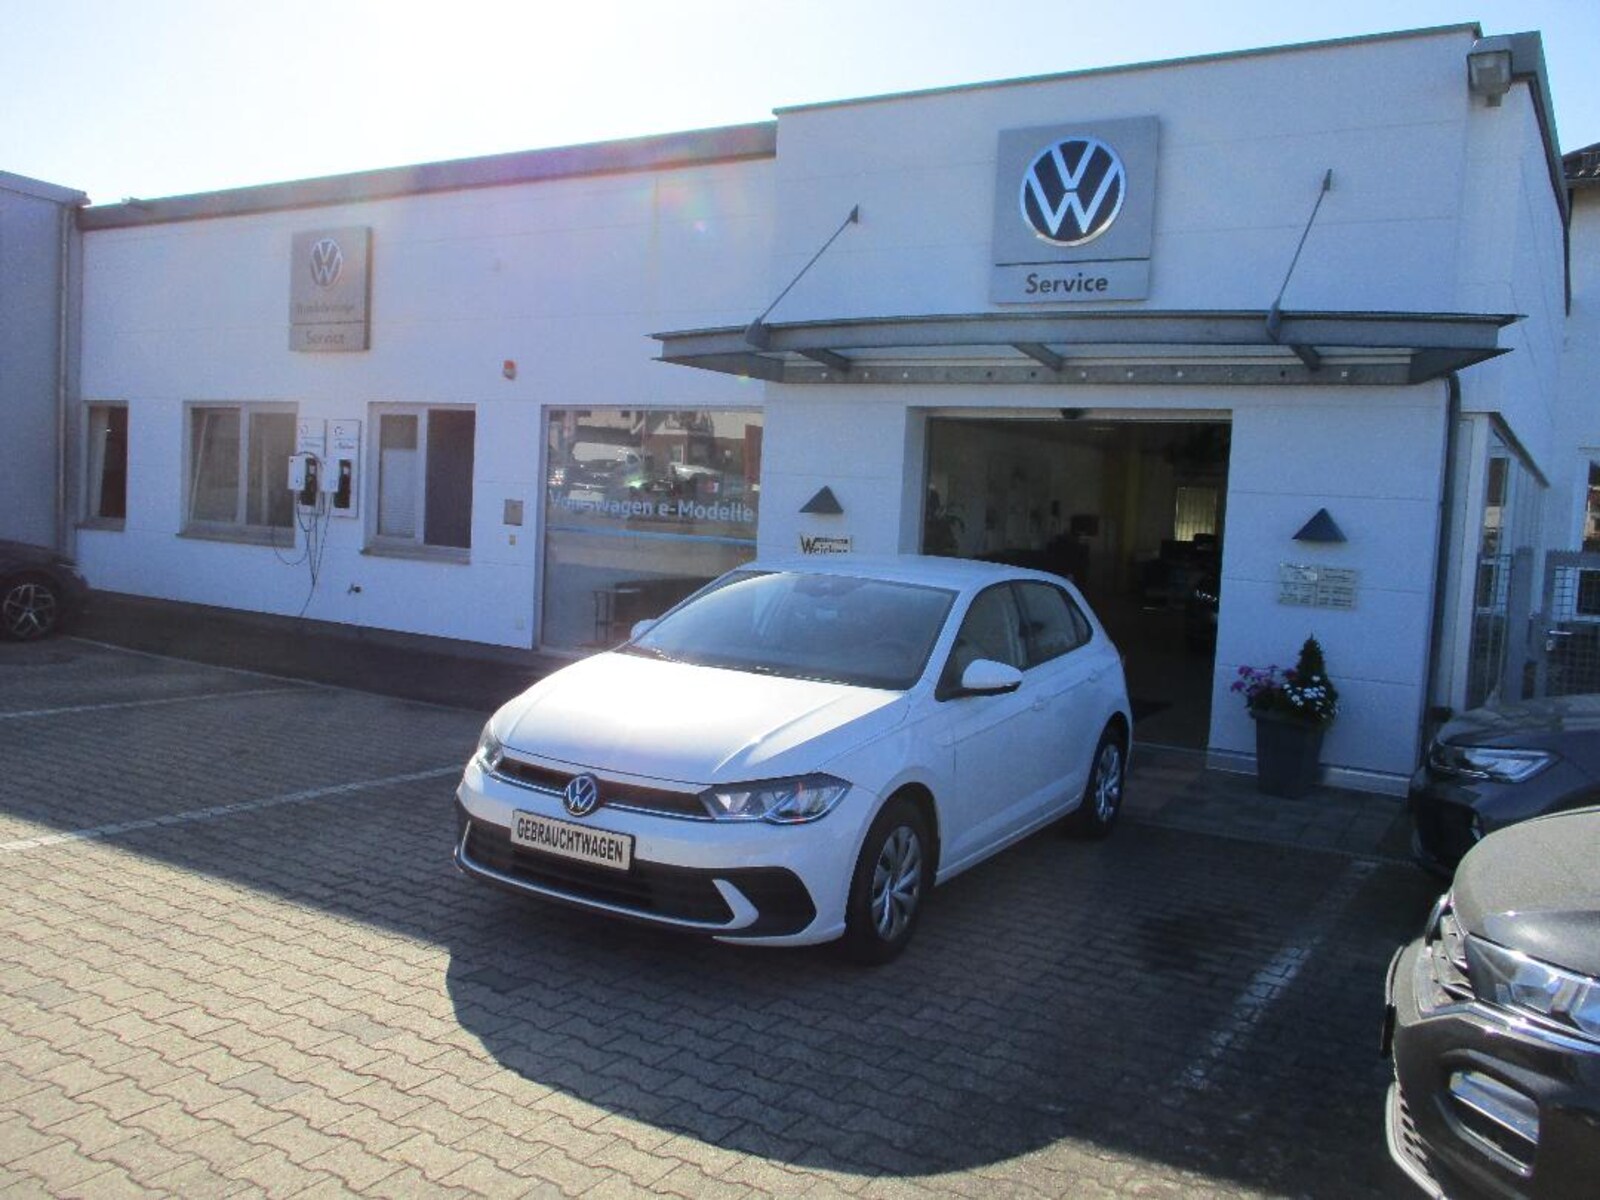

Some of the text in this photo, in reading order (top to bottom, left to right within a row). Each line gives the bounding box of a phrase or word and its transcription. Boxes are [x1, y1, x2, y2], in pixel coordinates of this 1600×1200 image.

[1019, 136, 1126, 247] VW
[1025, 272, 1109, 294] Service
[658, 499, 754, 522] e-Modelle
[564, 775, 597, 816] VW
[516, 816, 624, 863] GEBRAUCHTWAGEN
